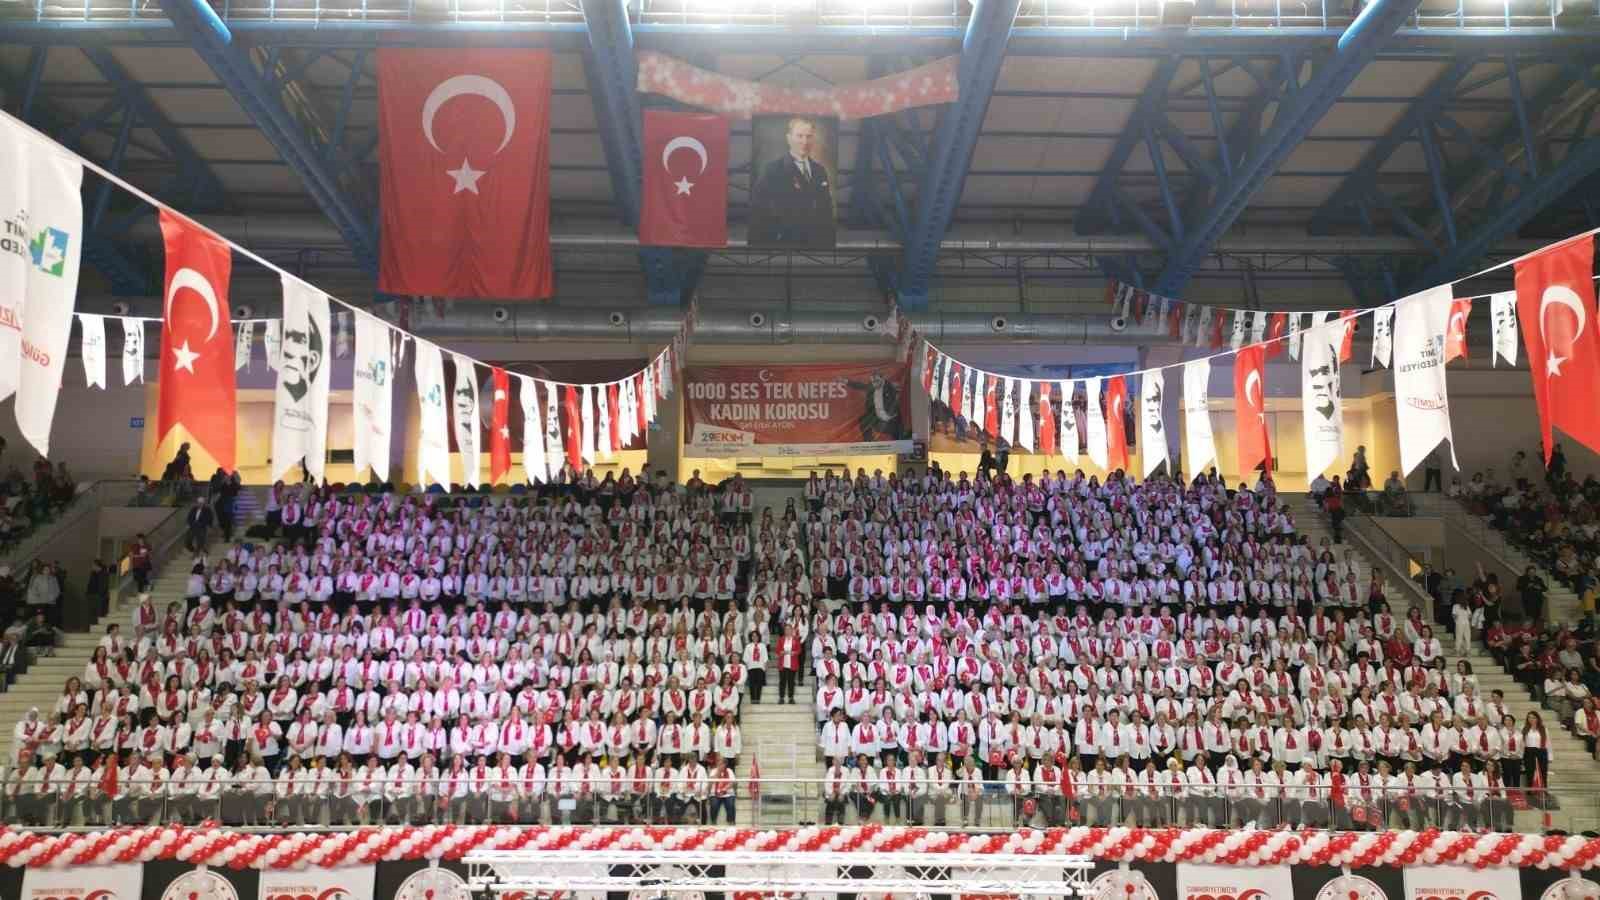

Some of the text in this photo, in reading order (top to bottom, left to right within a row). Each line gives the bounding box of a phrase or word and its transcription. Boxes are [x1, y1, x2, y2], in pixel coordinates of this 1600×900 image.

[687, 381, 848, 399] 1000 SES TEK NEFES
[710, 403, 829, 420] KADIN KOROSU
